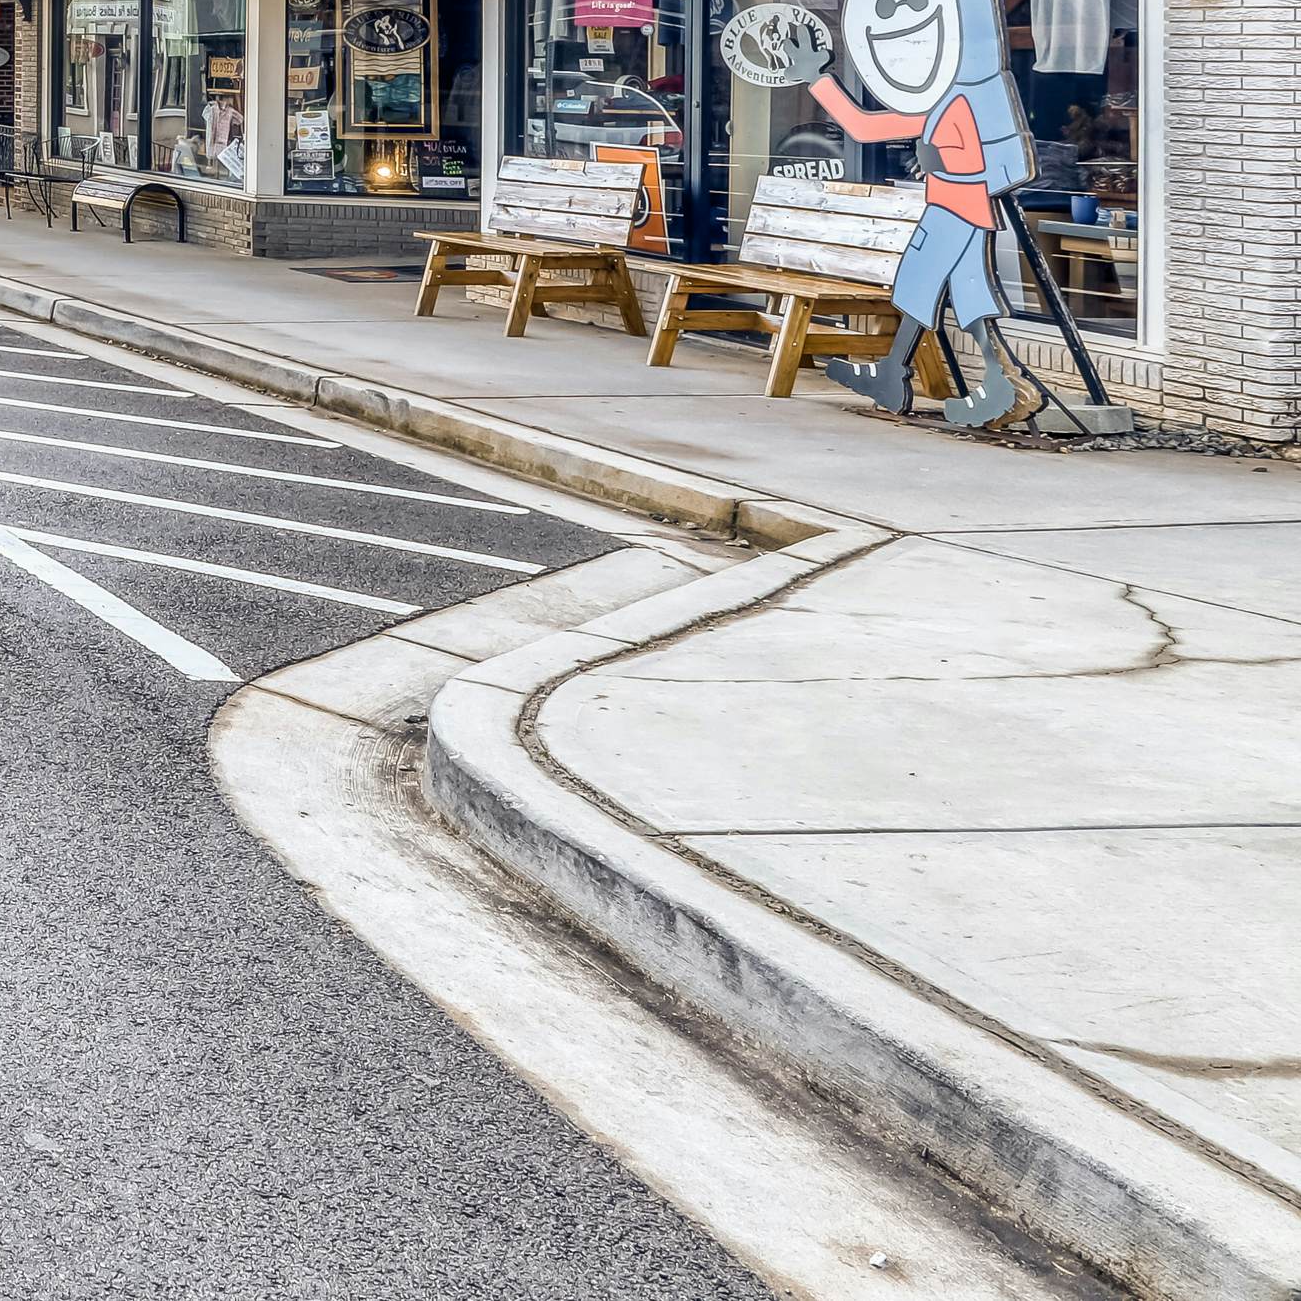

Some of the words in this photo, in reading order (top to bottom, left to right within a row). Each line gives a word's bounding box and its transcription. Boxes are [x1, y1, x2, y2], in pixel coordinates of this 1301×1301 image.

[591, 1, 605, 9] Life
[724, 10, 759, 50] BLUE
[727, 53, 786, 84] Adventure
